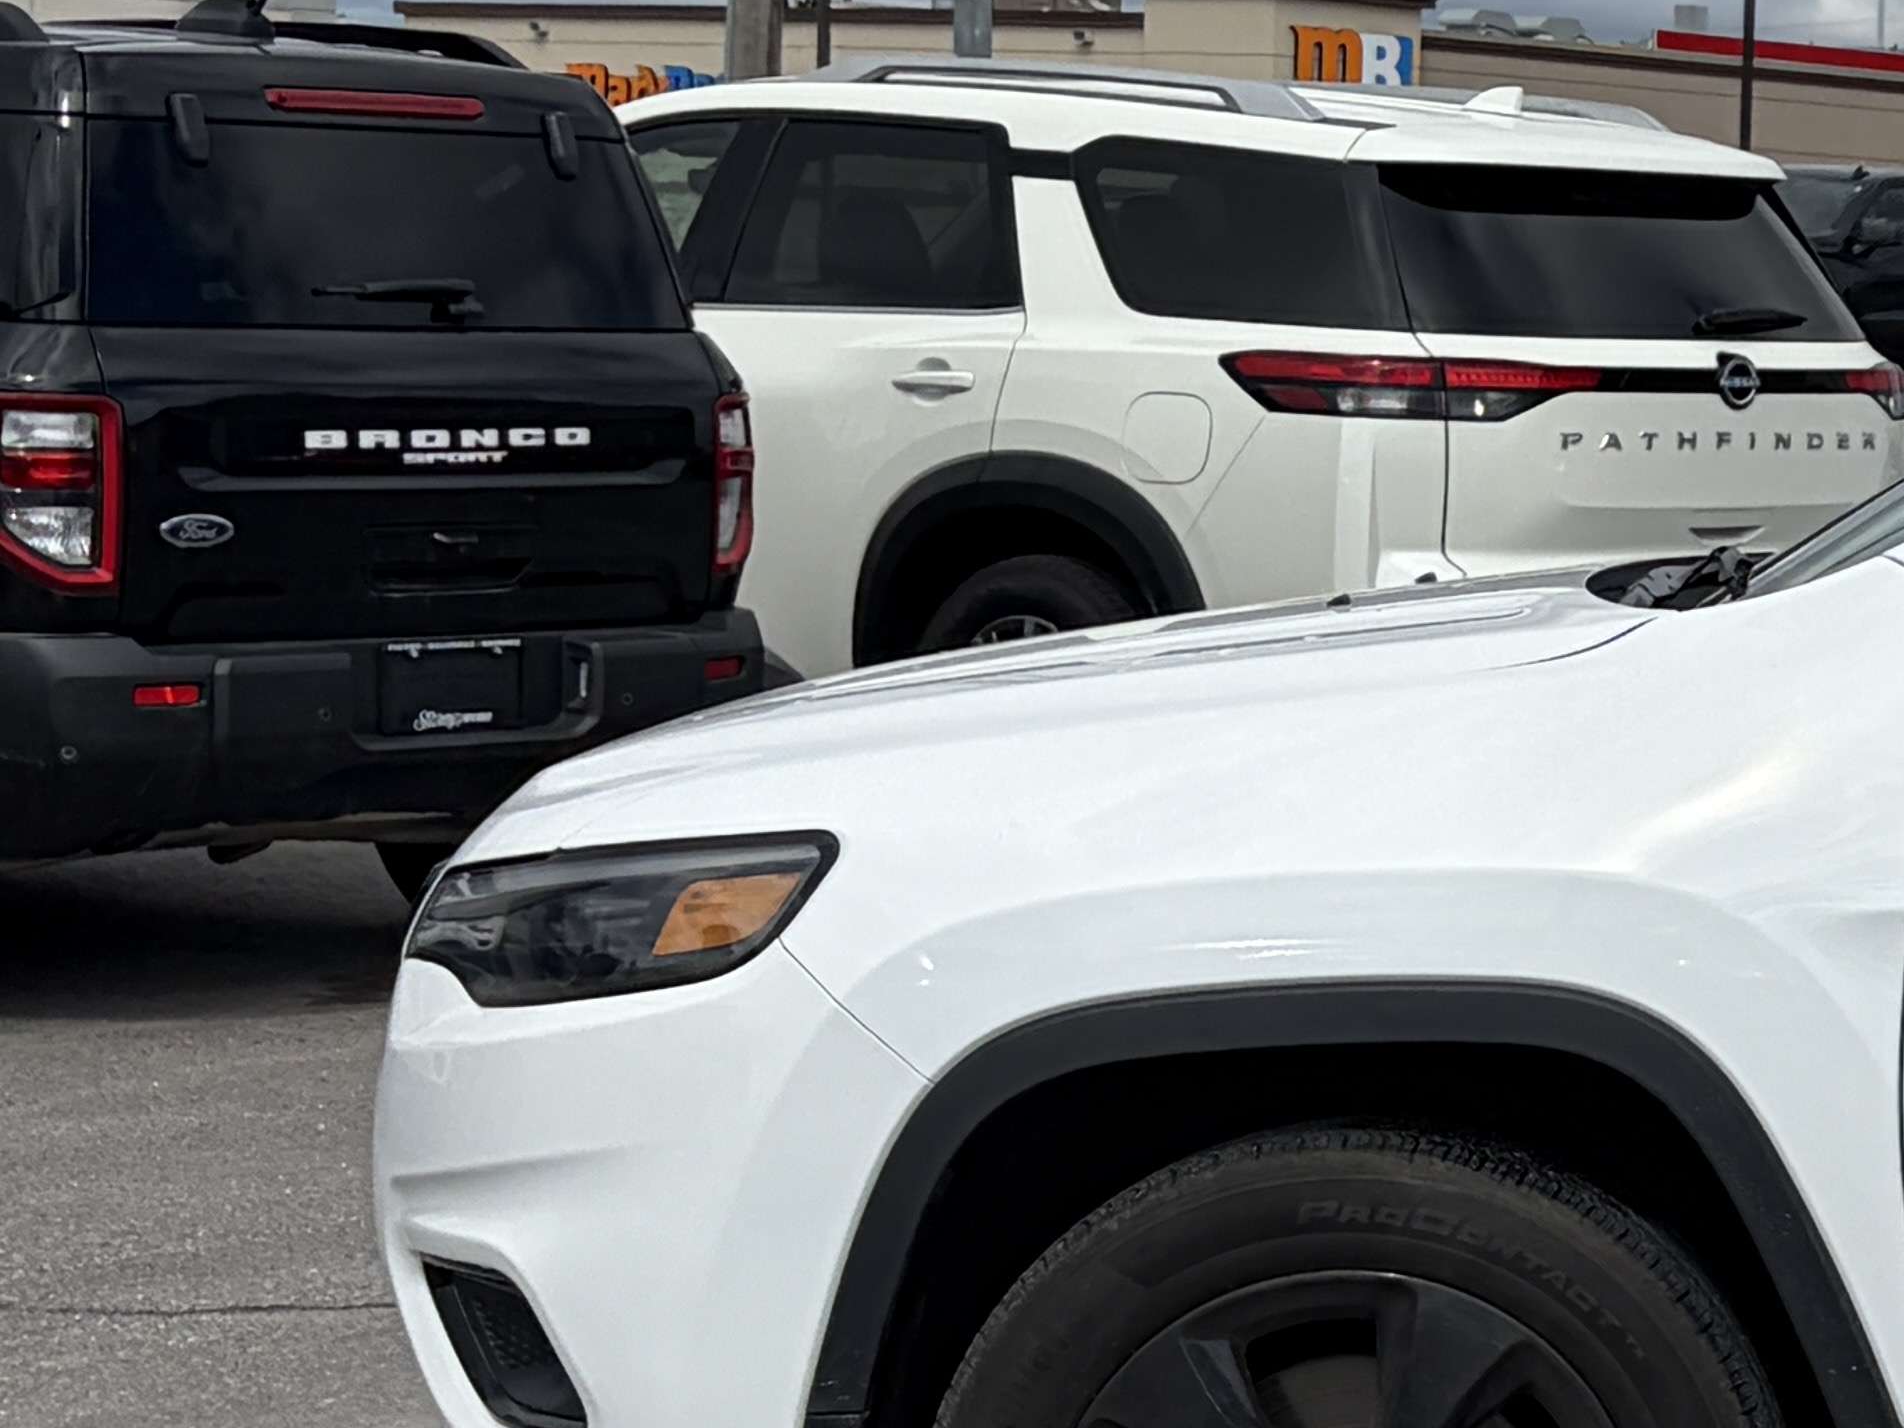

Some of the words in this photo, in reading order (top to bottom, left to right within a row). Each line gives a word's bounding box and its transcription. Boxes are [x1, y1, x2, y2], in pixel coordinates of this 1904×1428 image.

[304, 427, 591, 450] BRONCO
[1560, 431, 1876, 452] PATHFINDER
[403, 450, 509, 465] SPORT
